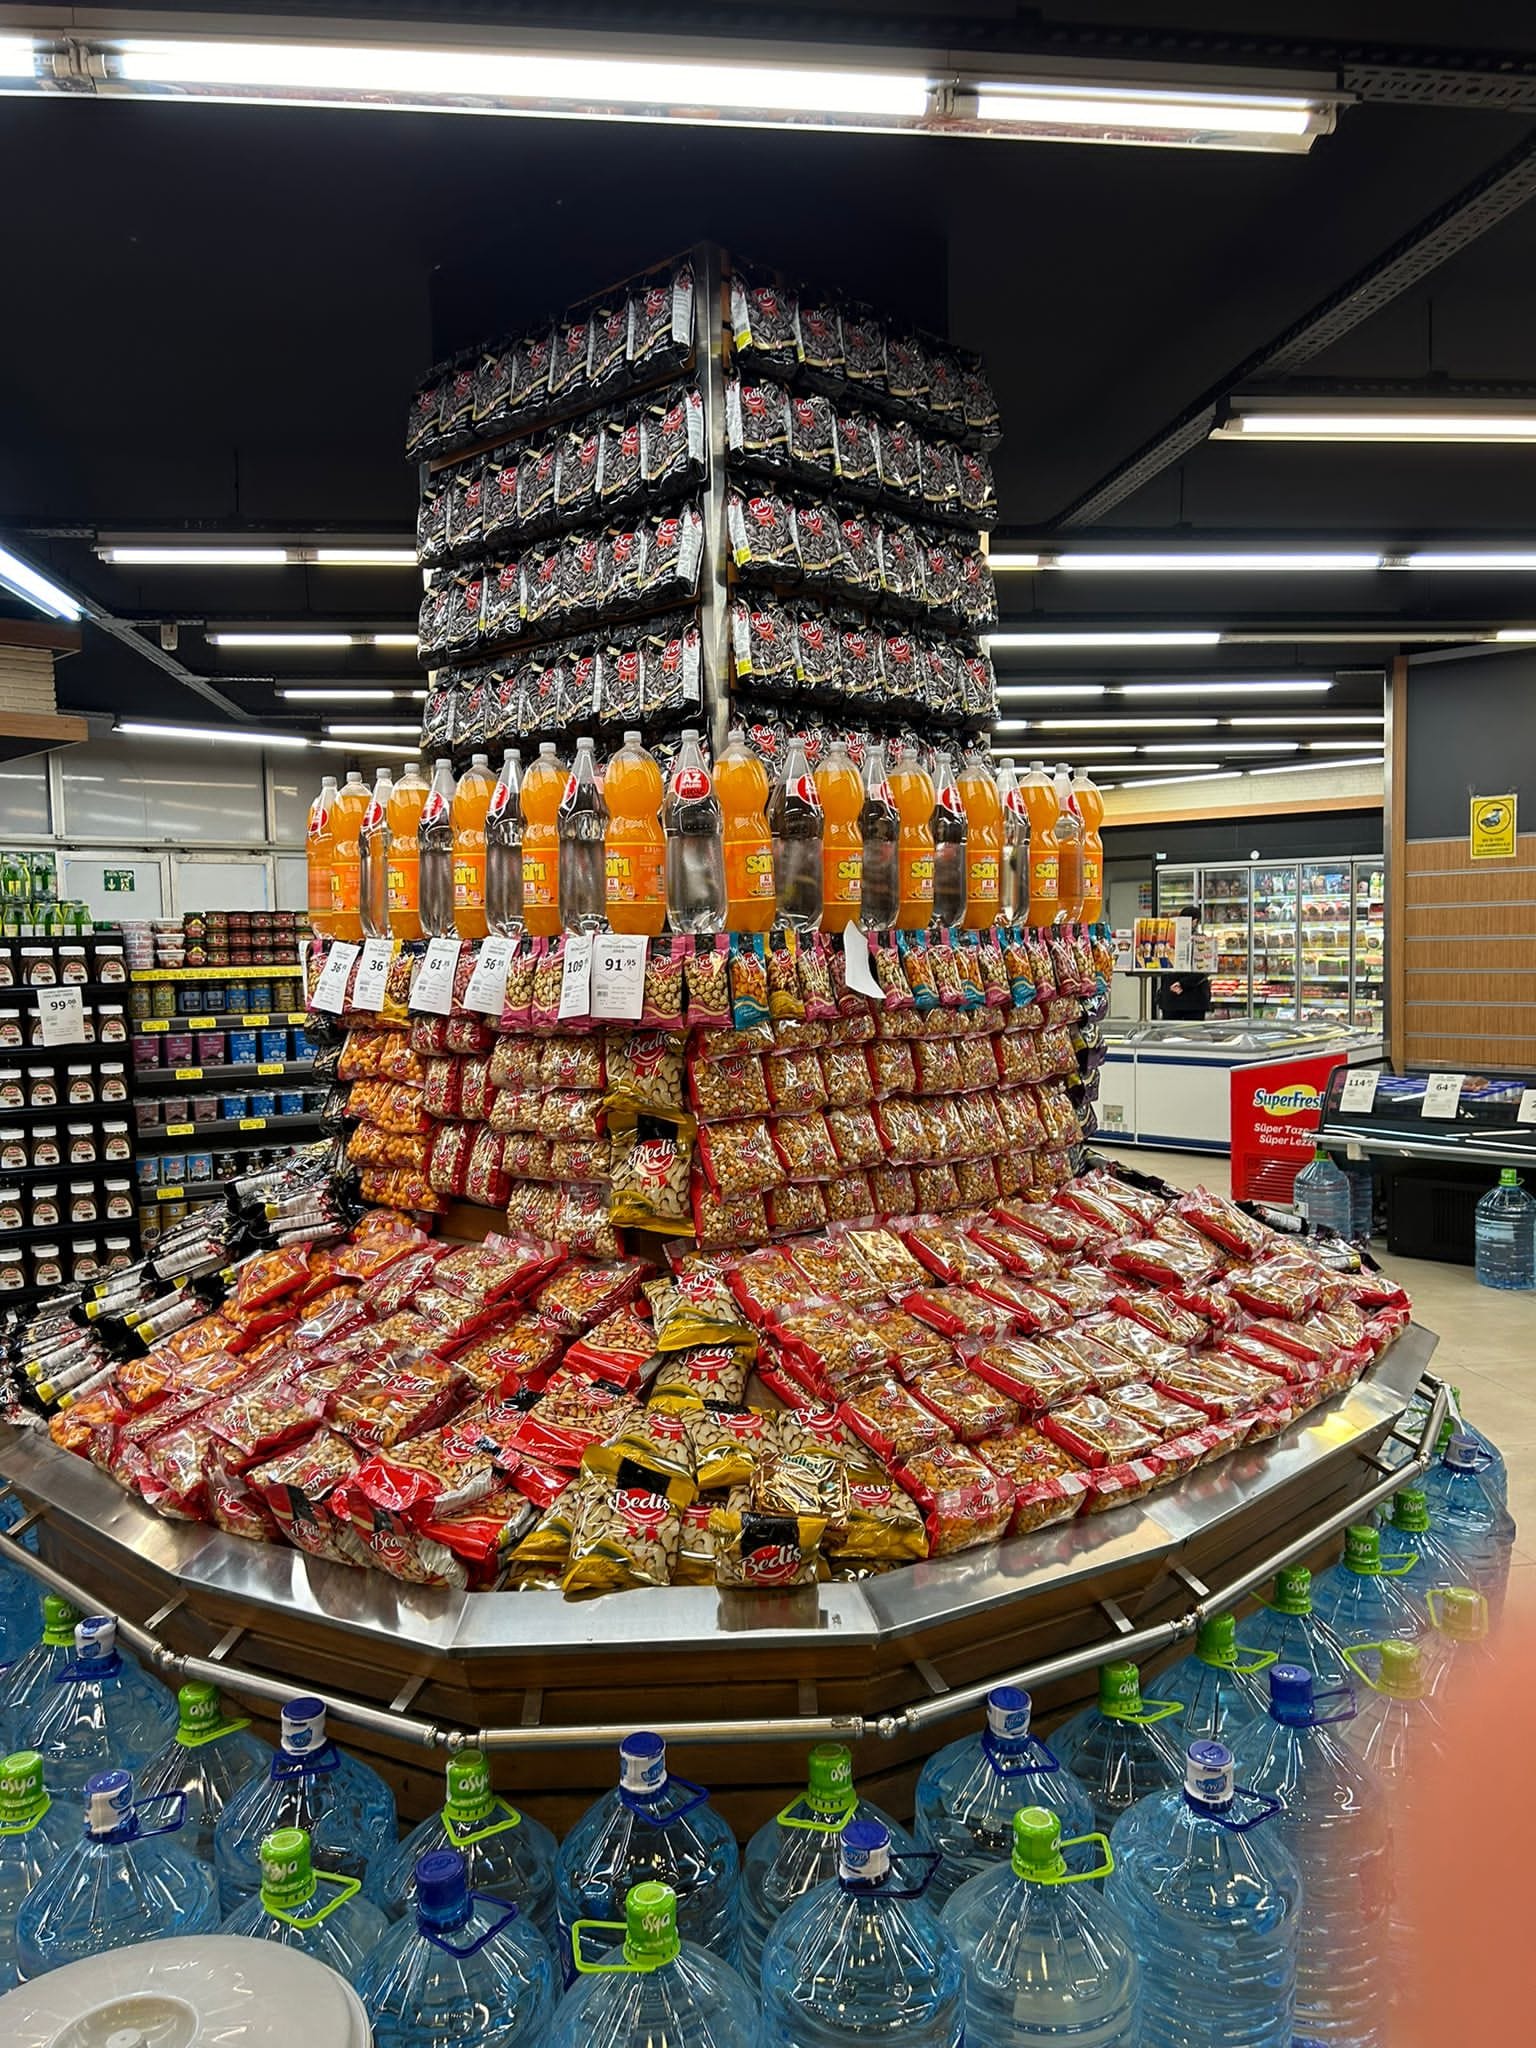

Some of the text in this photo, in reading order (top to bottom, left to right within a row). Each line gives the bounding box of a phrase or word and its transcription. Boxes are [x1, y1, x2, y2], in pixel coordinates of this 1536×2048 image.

[624, 1031, 670, 1059] Bedis
[1254, 1122, 1283, 1135] Süper
[1259, 1134, 1289, 1147] Süper
[607, 1488, 672, 1513] Bedis
[736, 1543, 802, 1582] Bedis
